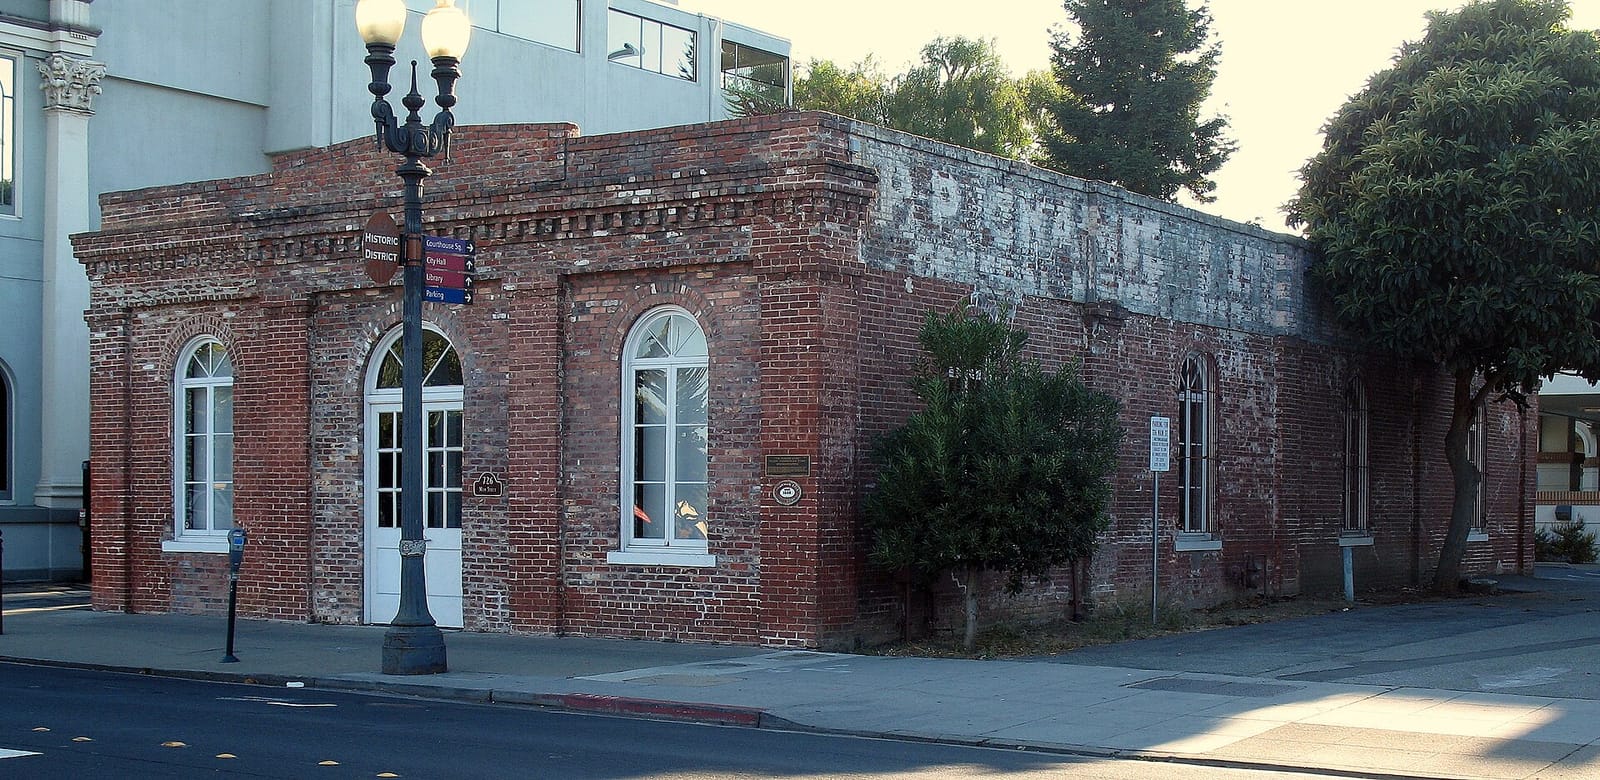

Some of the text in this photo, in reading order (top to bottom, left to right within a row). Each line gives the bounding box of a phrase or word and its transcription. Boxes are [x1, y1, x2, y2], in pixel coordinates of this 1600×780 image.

[365, 233, 399, 246] HISTORIC
[426, 240, 454, 250] Courthouse
[365, 249, 398, 262] DISTRICT
[426, 256, 447, 266] City Hall
[426, 273, 444, 284] Library
[426, 289, 445, 300] Parking
[483, 476, 493, 485] 726
